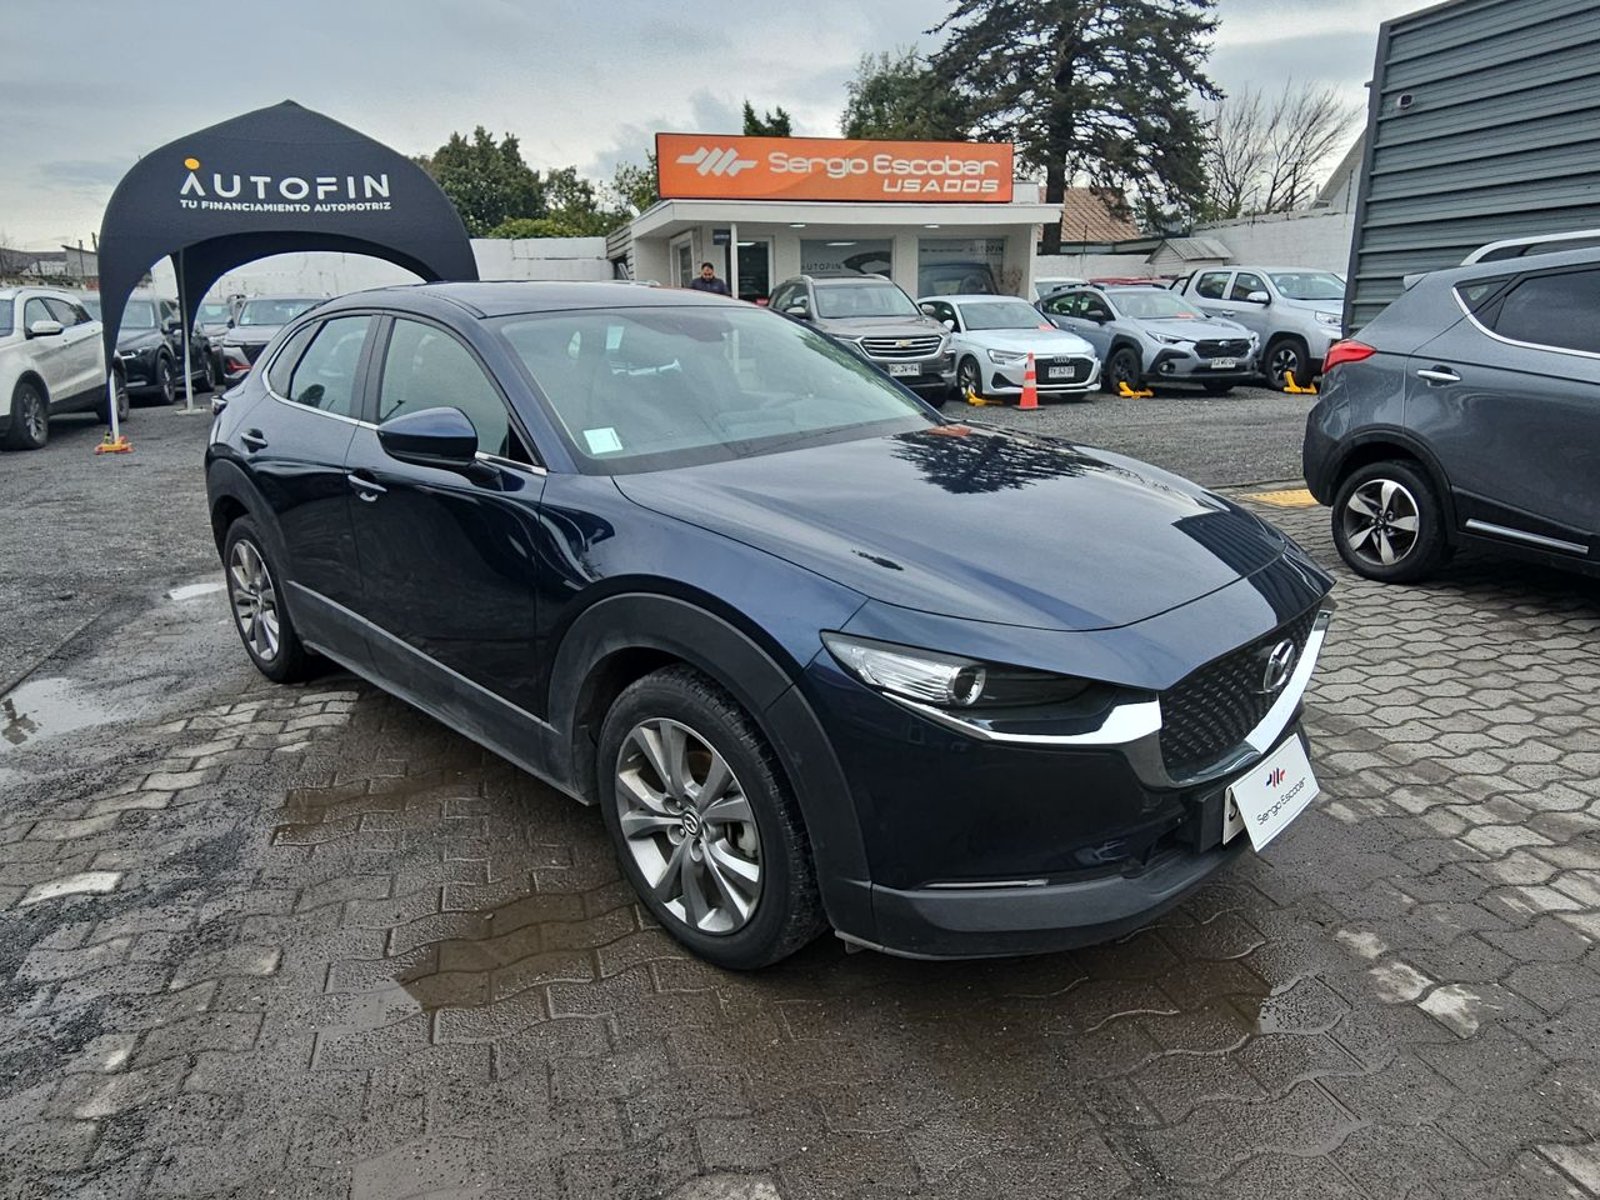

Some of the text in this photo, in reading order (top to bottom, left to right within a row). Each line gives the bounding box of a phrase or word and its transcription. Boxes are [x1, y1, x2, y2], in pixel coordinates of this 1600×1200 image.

[768, 152, 999, 179] Sergio Escobar
[179, 171, 391, 200] AUTOFIN
[882, 179, 999, 193] USADOS
[179, 199, 392, 212] TU FINANCIAMIENTO AUTOMOTRIZ
